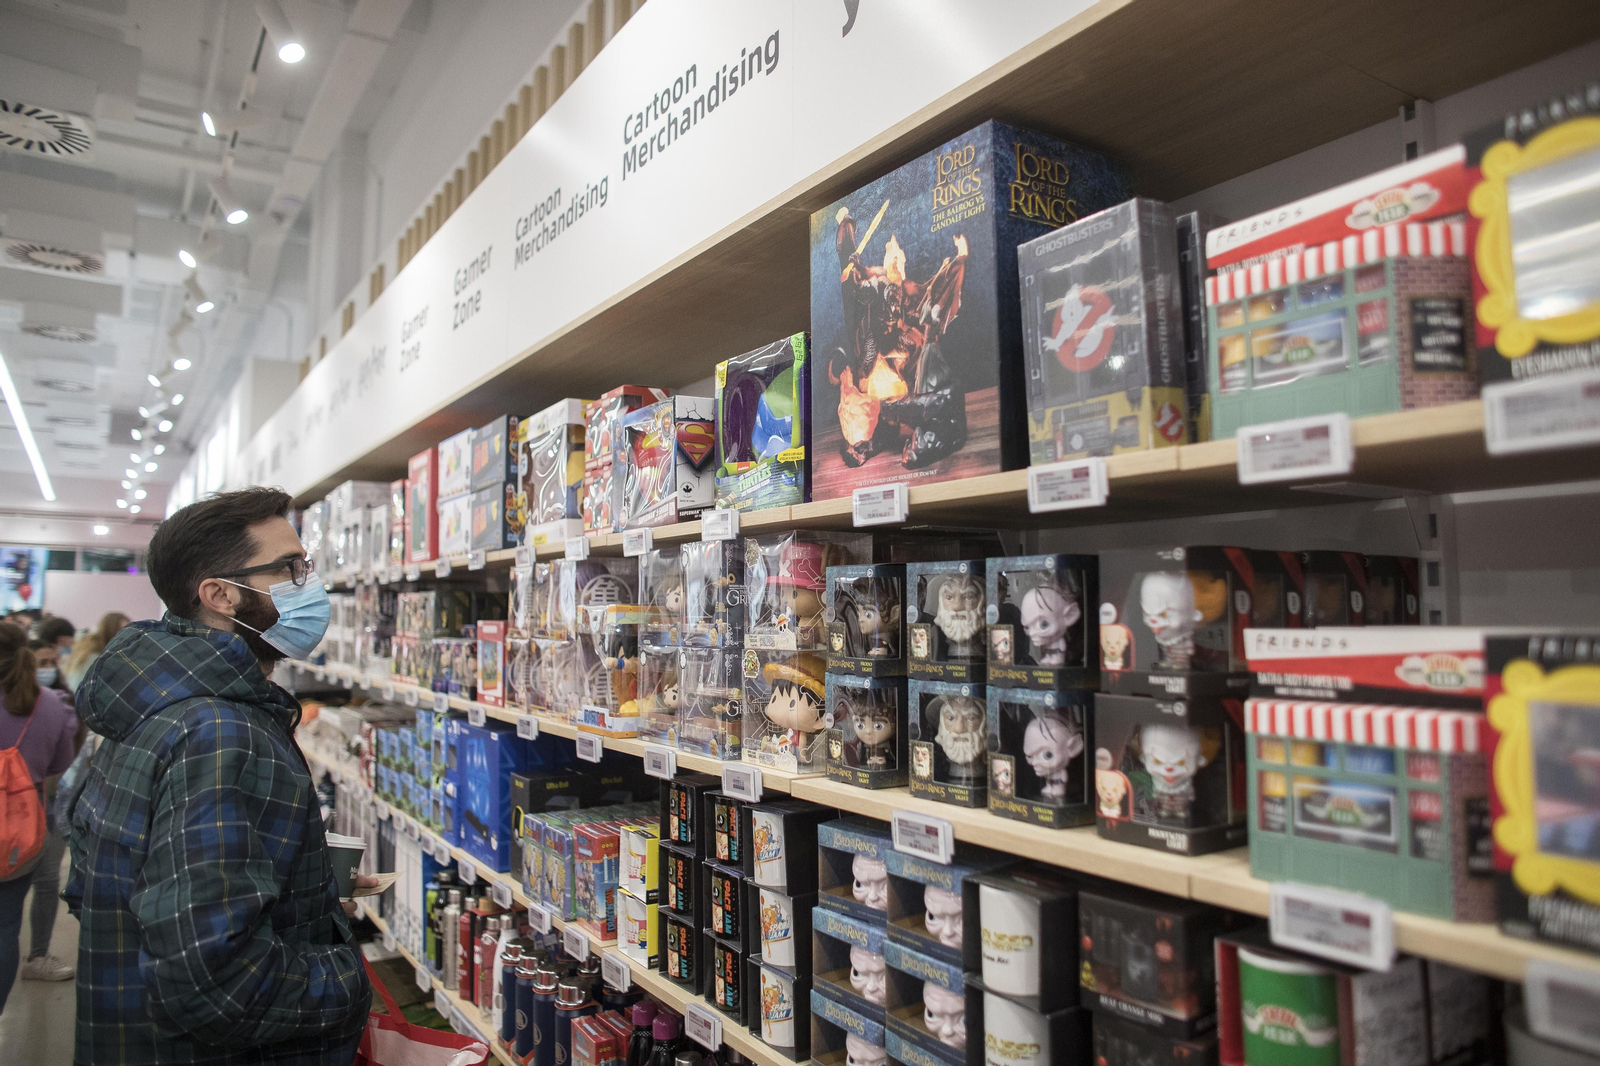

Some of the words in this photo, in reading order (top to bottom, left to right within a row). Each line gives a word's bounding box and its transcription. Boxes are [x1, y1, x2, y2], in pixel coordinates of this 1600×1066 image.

[622, 29, 780, 181] Merchandising
[623, 63, 698, 145] Cartoon
[936, 144, 975, 186] LORD
[1013, 141, 1070, 186] LORD
[932, 168, 982, 211] RINGS
[1008, 182, 1078, 224] RINGS
[1031, 181, 1045, 192] OF
[1047, 185, 1066, 198] THE
[514, 186, 562, 242] Cartoon
[514, 175, 609, 270] Merchandising
[931, 214, 963, 233] GANDALF
[964, 202, 987, 219] LIGHT
[932, 211, 945, 224] THE
[946, 199, 975, 217] BALROG
[1035, 217, 1114, 257] GHOSTBUSTERS
[453, 244, 493, 297] Gamer
[401, 305, 429, 344] Gamer
[452, 287, 482, 331] Zone
[728, 806, 737, 838] SPACE
[730, 837, 739, 861] JAM
[760, 851, 776, 860] JAM
[833, 833, 850, 848] LORD
[854, 838, 878, 857] RINGS
[928, 868, 952, 889] RINGS
[724, 911, 732, 935] JAM
[768, 929, 785, 939] JAM
[827, 916, 844, 933] LORD
[848, 926, 868, 946] RINGS
[680, 956, 688, 978] JAM
[725, 951, 733, 985] SPACE
[901, 952, 919, 970] LORD
[924, 964, 949, 987] RINGS
[770, 1010, 786, 1020] JAM
[825, 1001, 840, 1018] LORD
[844, 1014, 865, 1035] RINGS
